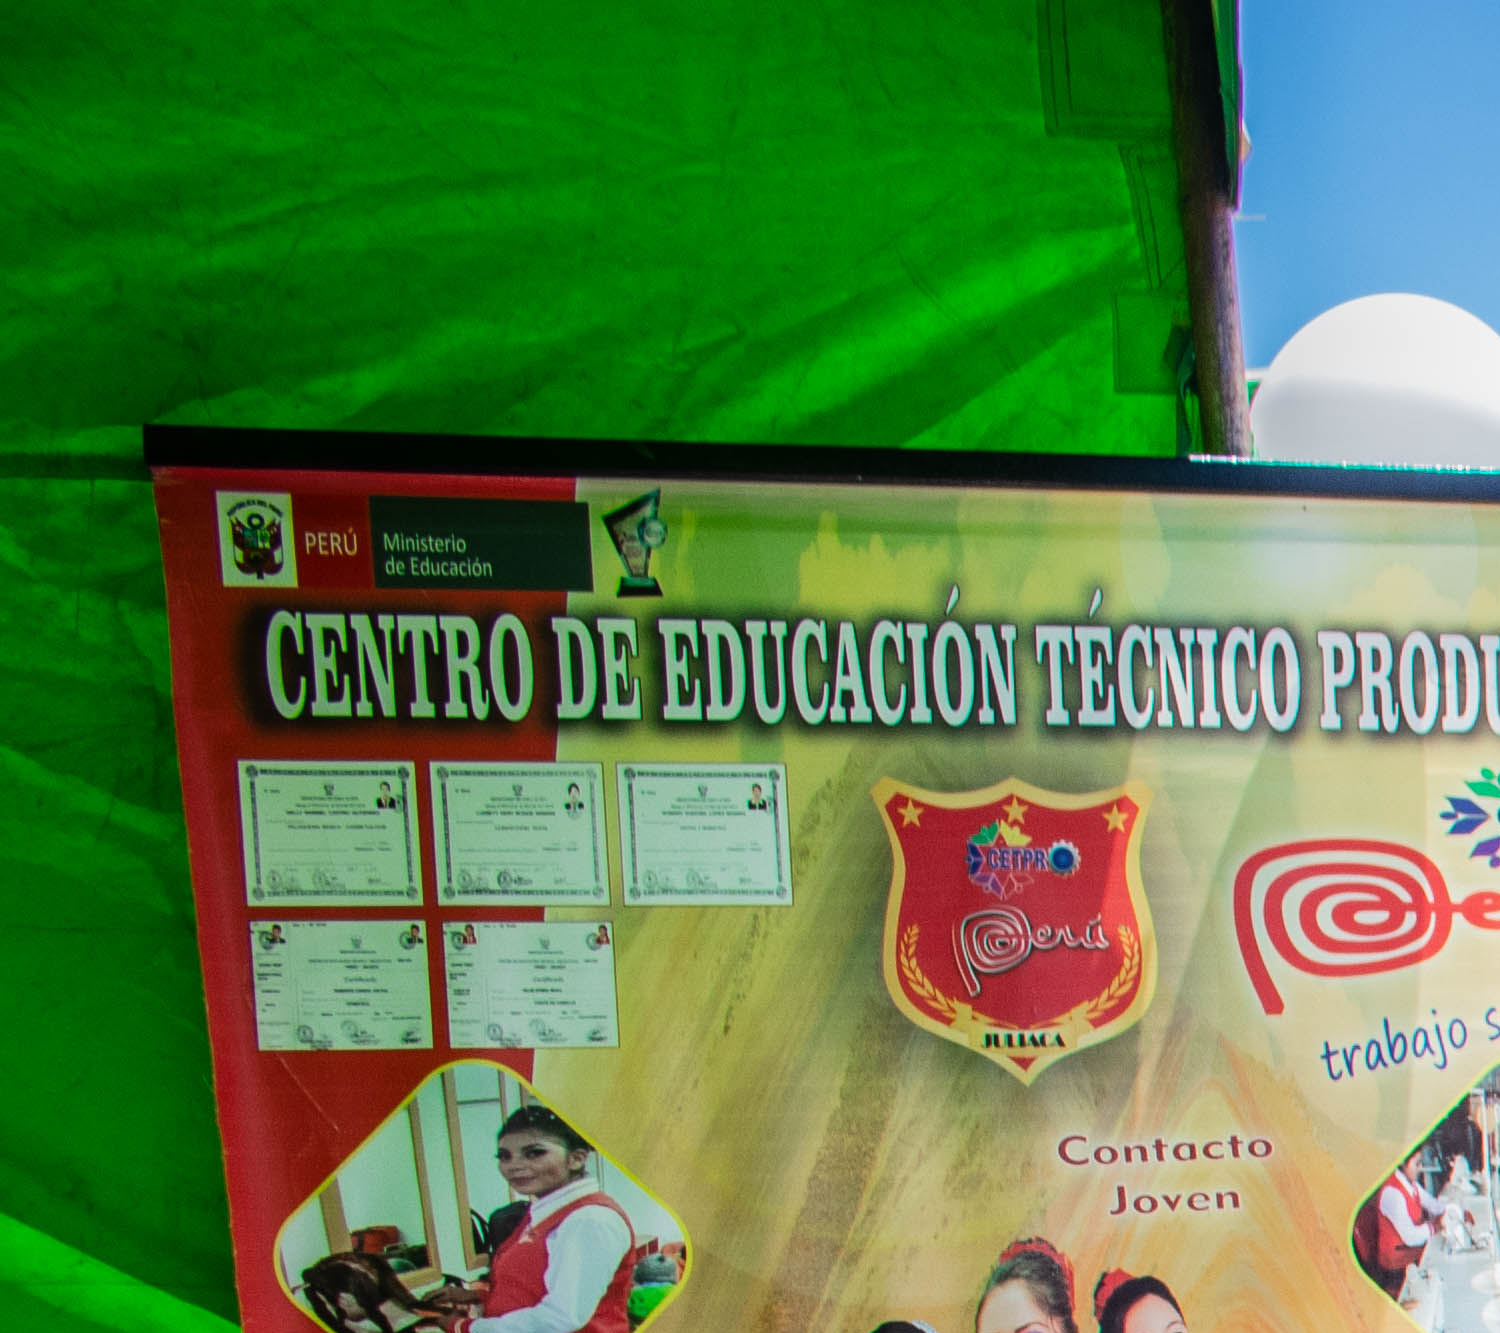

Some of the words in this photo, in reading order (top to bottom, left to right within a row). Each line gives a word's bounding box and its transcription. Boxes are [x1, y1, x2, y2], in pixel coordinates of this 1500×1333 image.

[304, 528, 358, 556] PERÚ
[383, 532, 467, 553] Ministerio
[385, 556, 406, 576] de
[411, 557, 493, 578] Educación
[265, 610, 535, 721] CENTRO
[551, 617, 642, 721] DE
[664, 584, 1017, 727] EDUCACIÓN
[1034, 587, 1302, 731] TÉCNICO
[983, 1030, 1067, 1049] JULIACA
[1320, 1008, 1469, 1082] trabajo
[1057, 1134, 1274, 1167] Contacto
[1110, 1184, 1241, 1216] Joven
